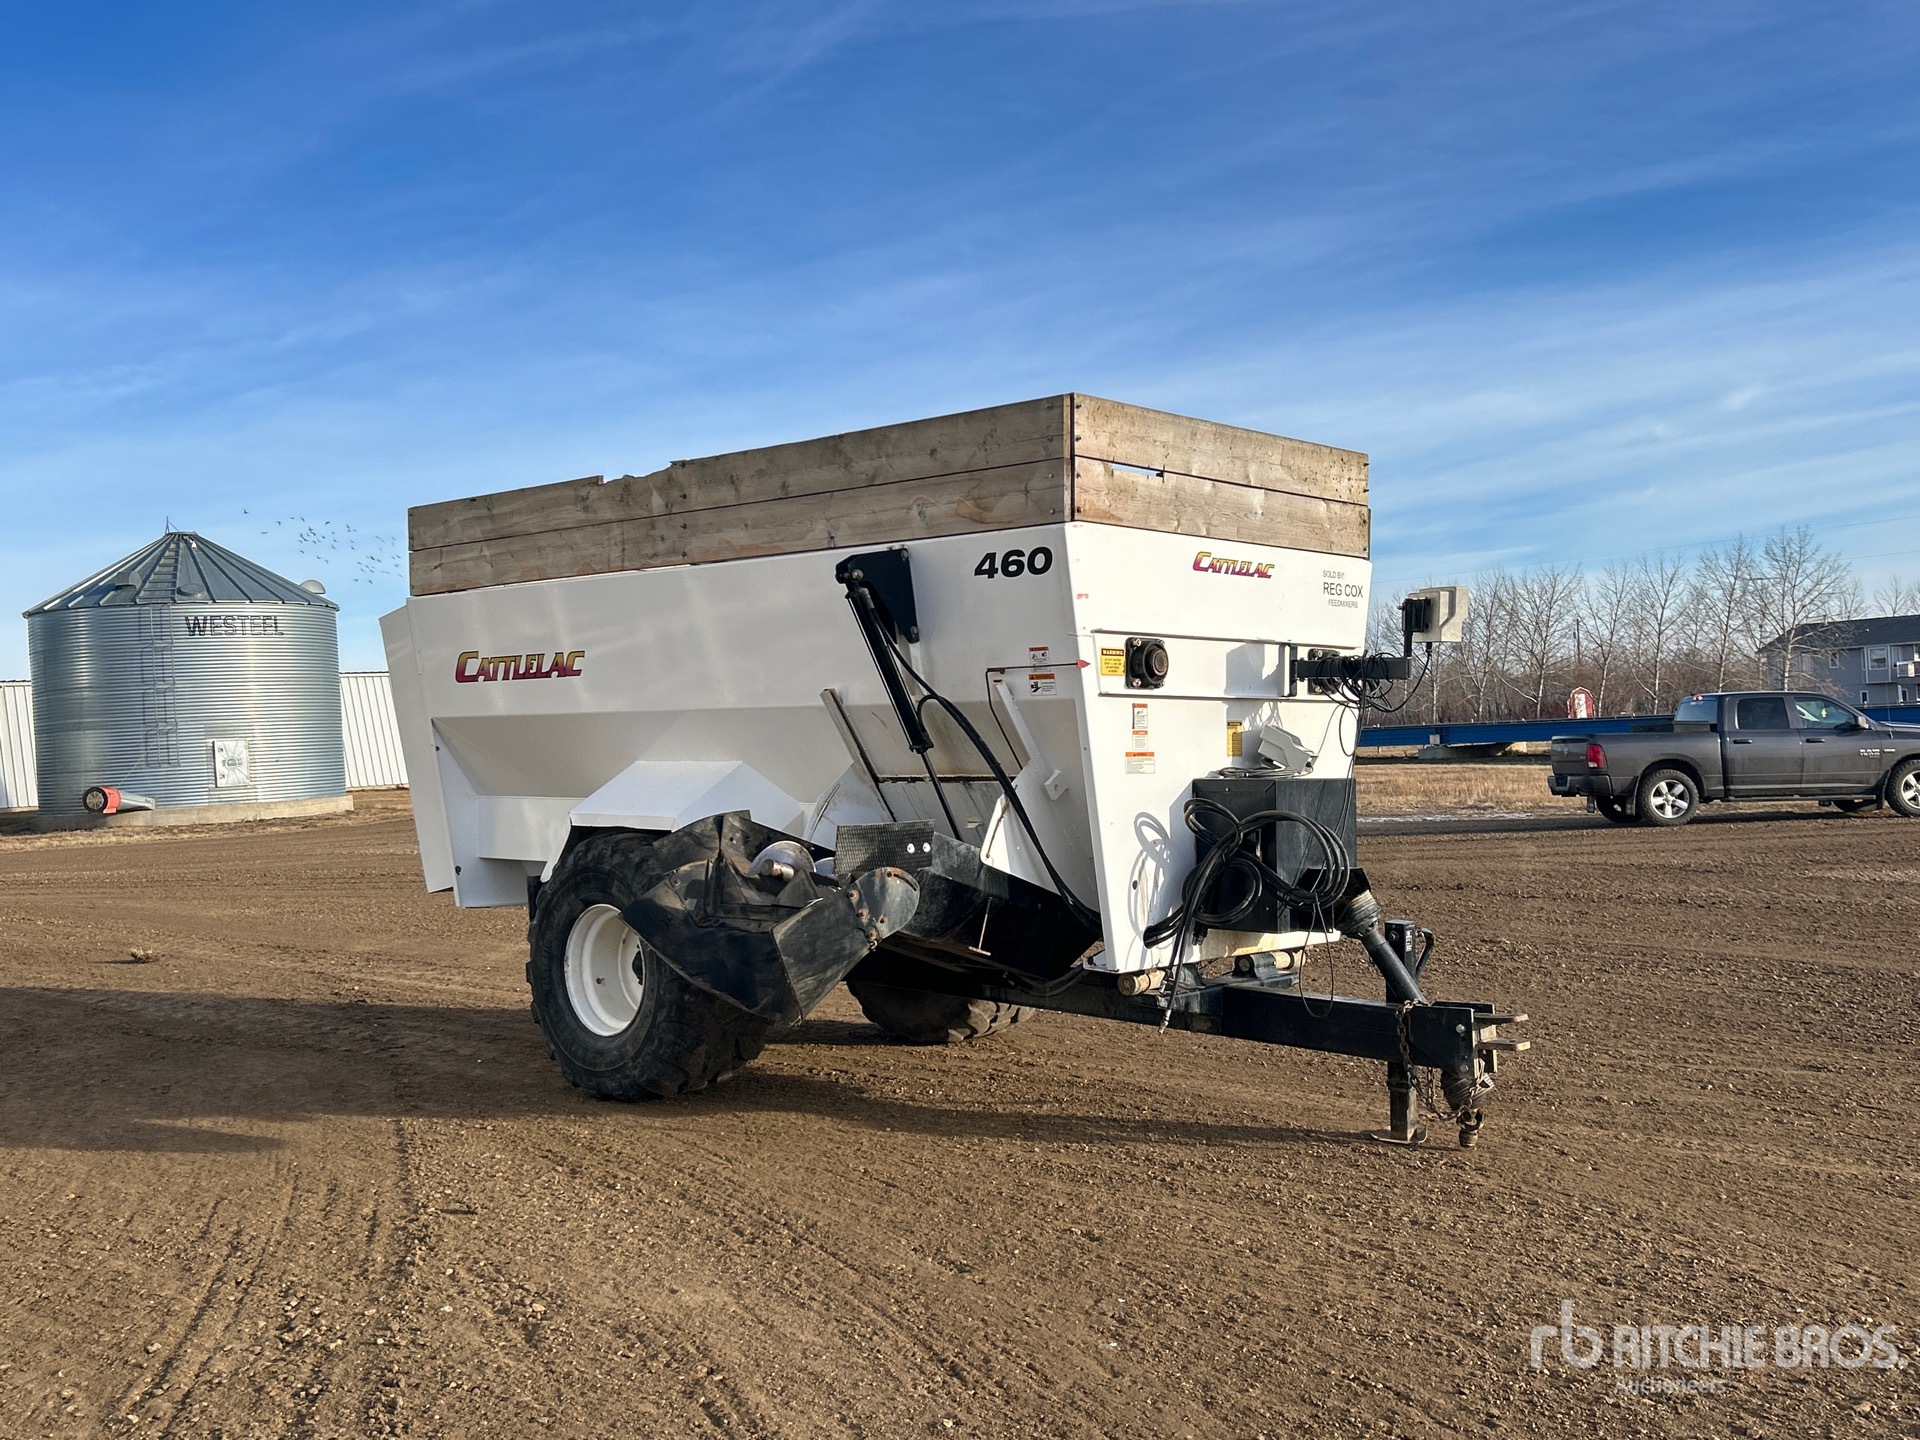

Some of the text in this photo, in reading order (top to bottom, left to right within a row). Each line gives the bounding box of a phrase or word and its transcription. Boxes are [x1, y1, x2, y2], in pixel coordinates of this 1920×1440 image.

[974, 546, 1053, 579] 460
[1192, 551, 1275, 579] CATTLELAC
[1322, 569, 1336, 579] SOLD
[1323, 581, 1364, 599] REG COX
[184, 615, 284, 636] WESTEEL
[455, 650, 585, 683] CATTLELAC
